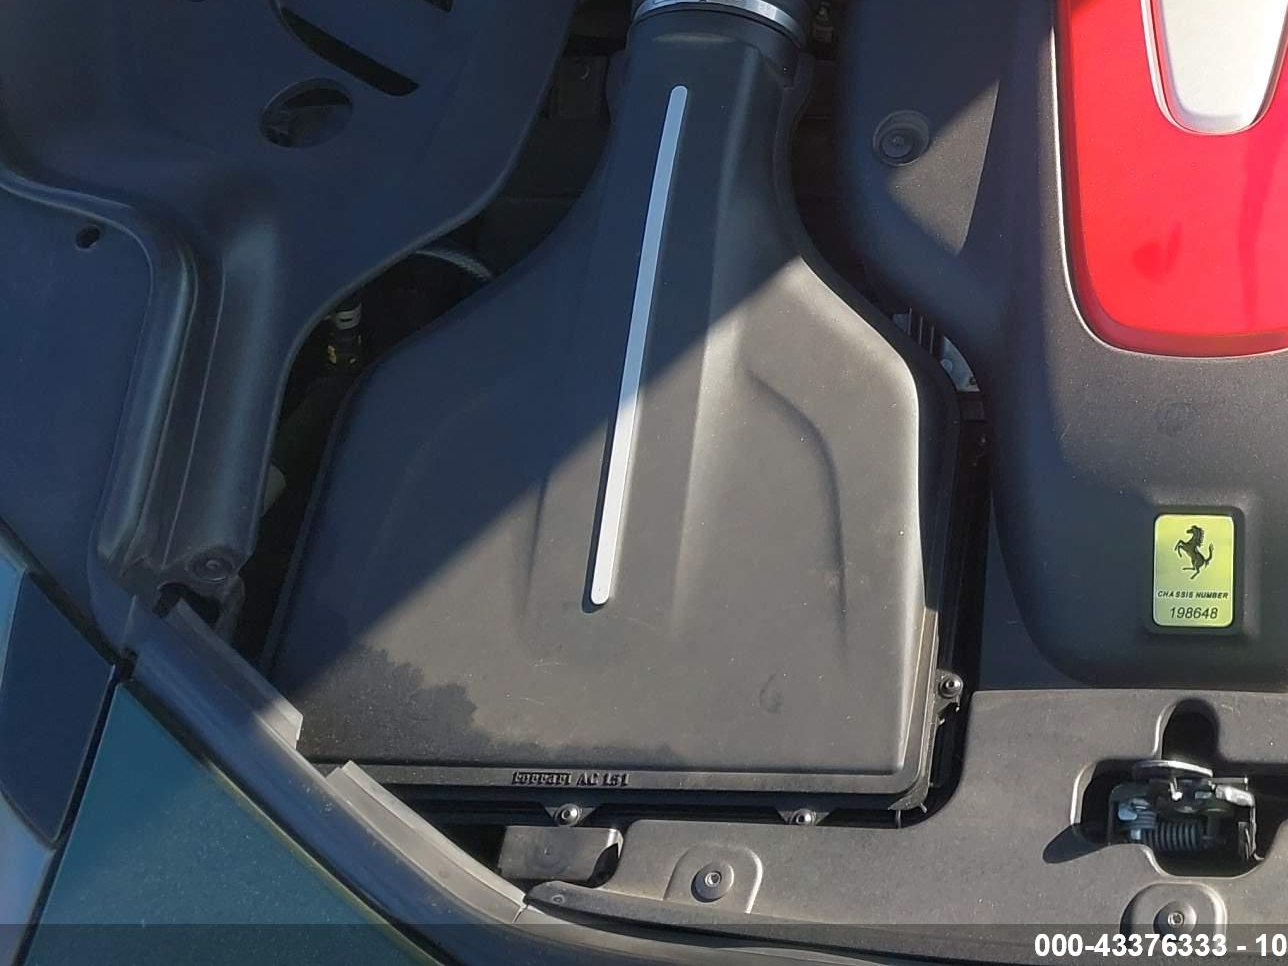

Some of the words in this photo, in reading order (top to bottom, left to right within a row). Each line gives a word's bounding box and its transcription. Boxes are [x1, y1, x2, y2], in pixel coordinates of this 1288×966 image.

[1157, 590, 1194, 599] CHASSIS
[1195, 591, 1229, 600] NUMBER
[1170, 606, 1219, 620] 198648
[576, 773, 600, 787] AC
